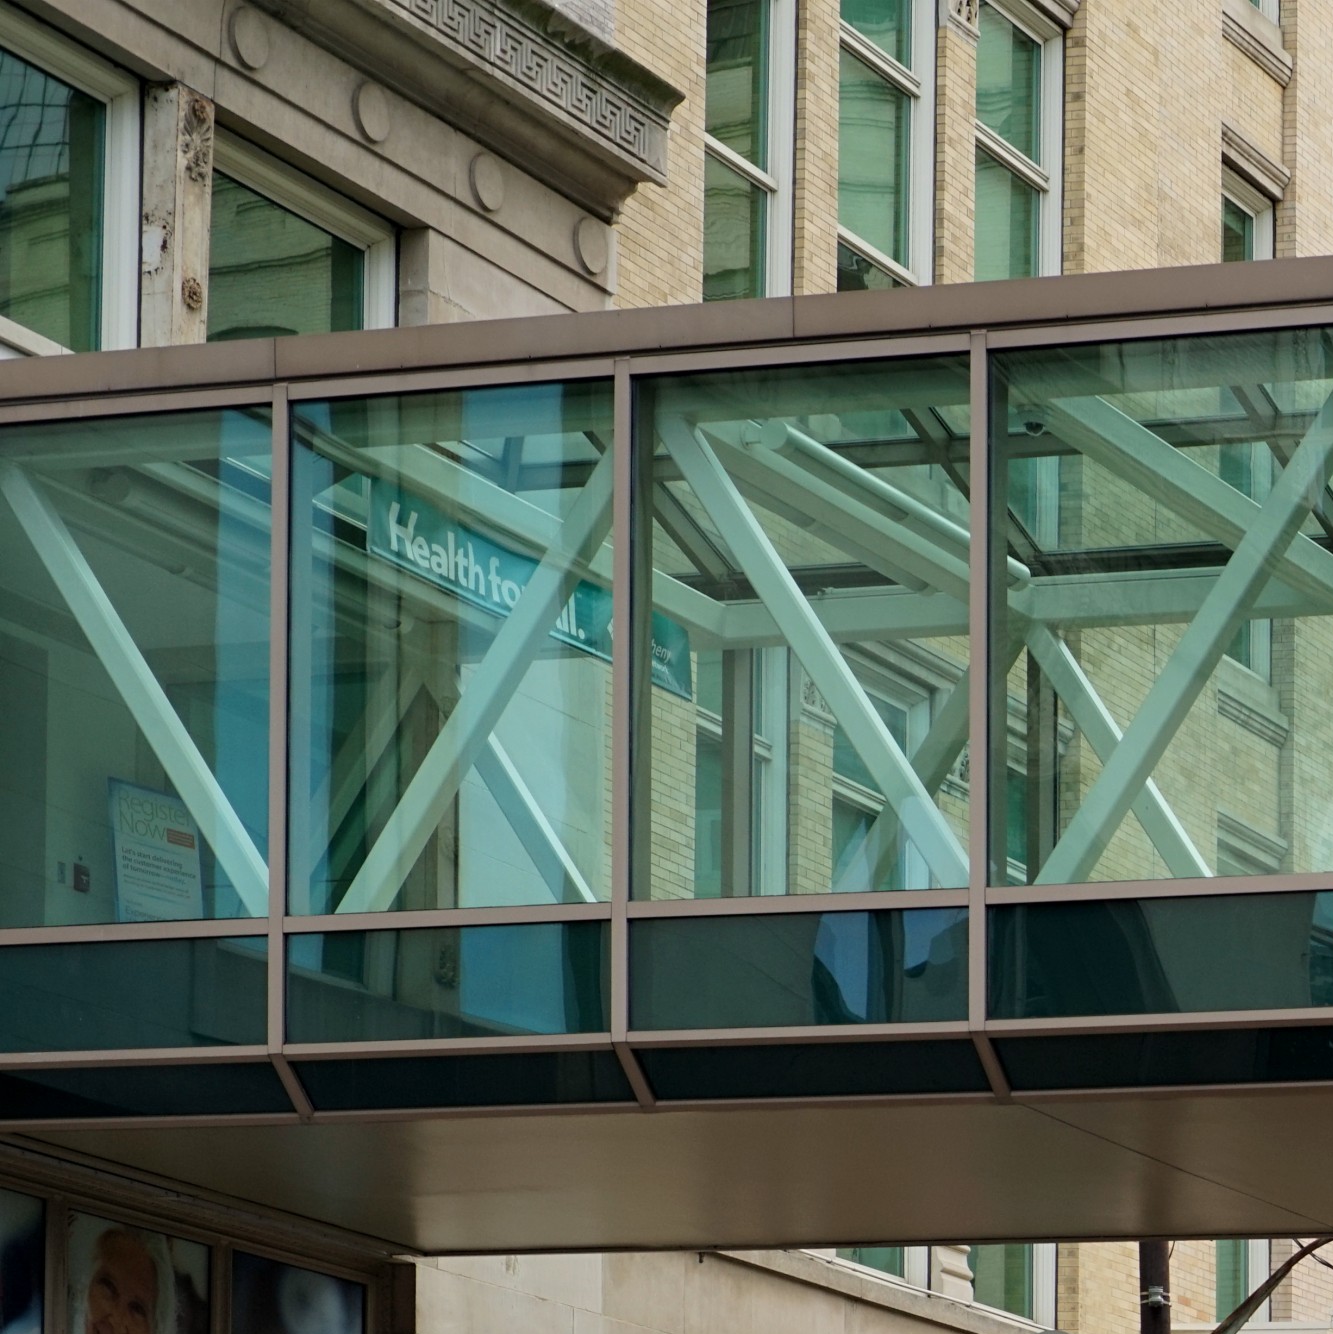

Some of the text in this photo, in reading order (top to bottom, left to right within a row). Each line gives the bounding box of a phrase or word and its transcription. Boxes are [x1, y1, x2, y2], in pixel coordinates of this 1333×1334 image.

[388, 501, 587, 640] Health fo ll.
[119, 791, 192, 826] Register
[120, 812, 167, 840] Now
